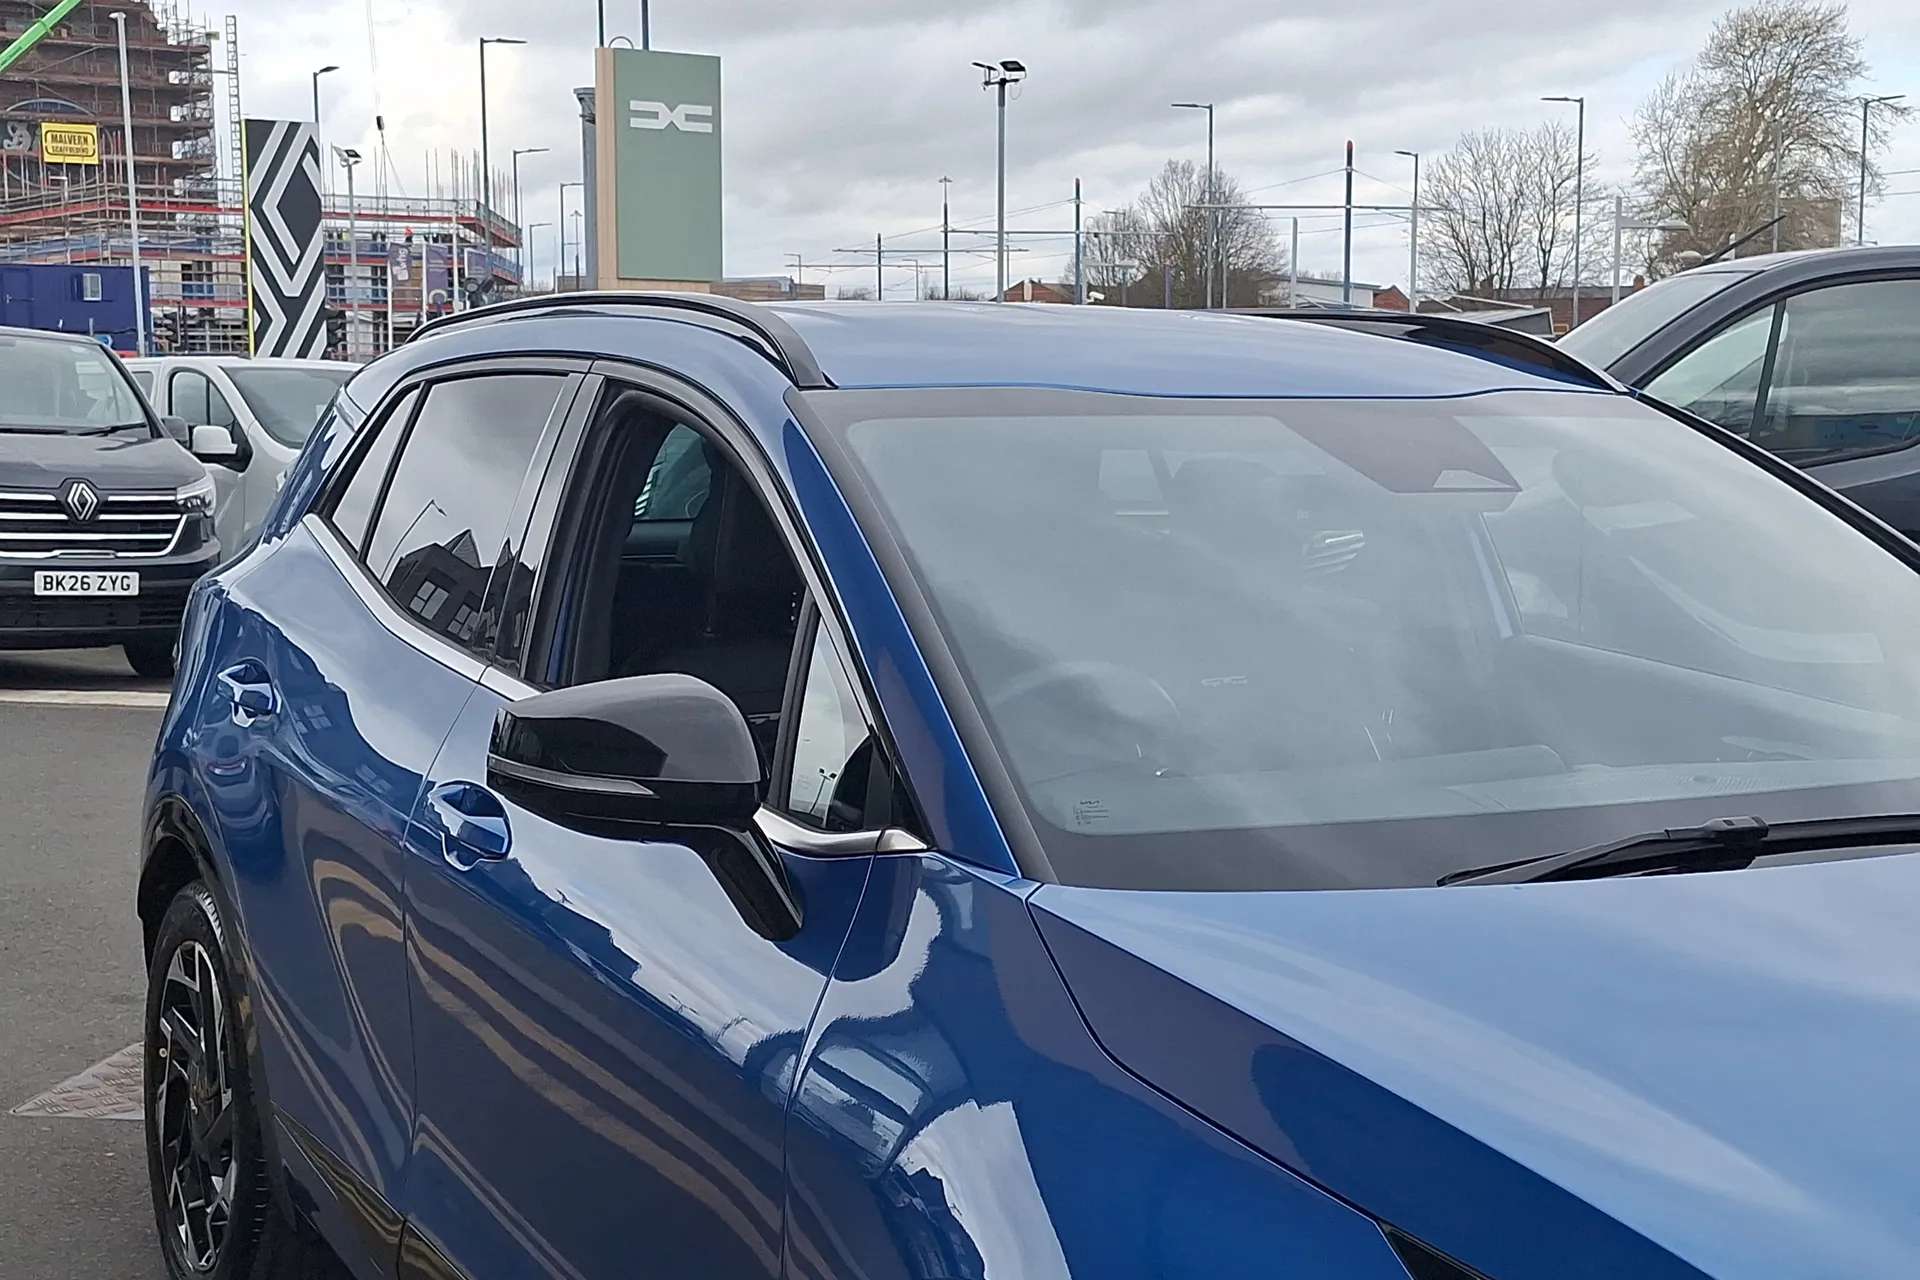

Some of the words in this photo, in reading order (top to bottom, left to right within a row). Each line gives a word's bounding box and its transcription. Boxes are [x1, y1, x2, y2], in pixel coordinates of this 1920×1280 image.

[51, 133, 88, 145] MALVERN
[42, 575, 91, 591] BK26
[96, 575, 131, 591] ZYG
